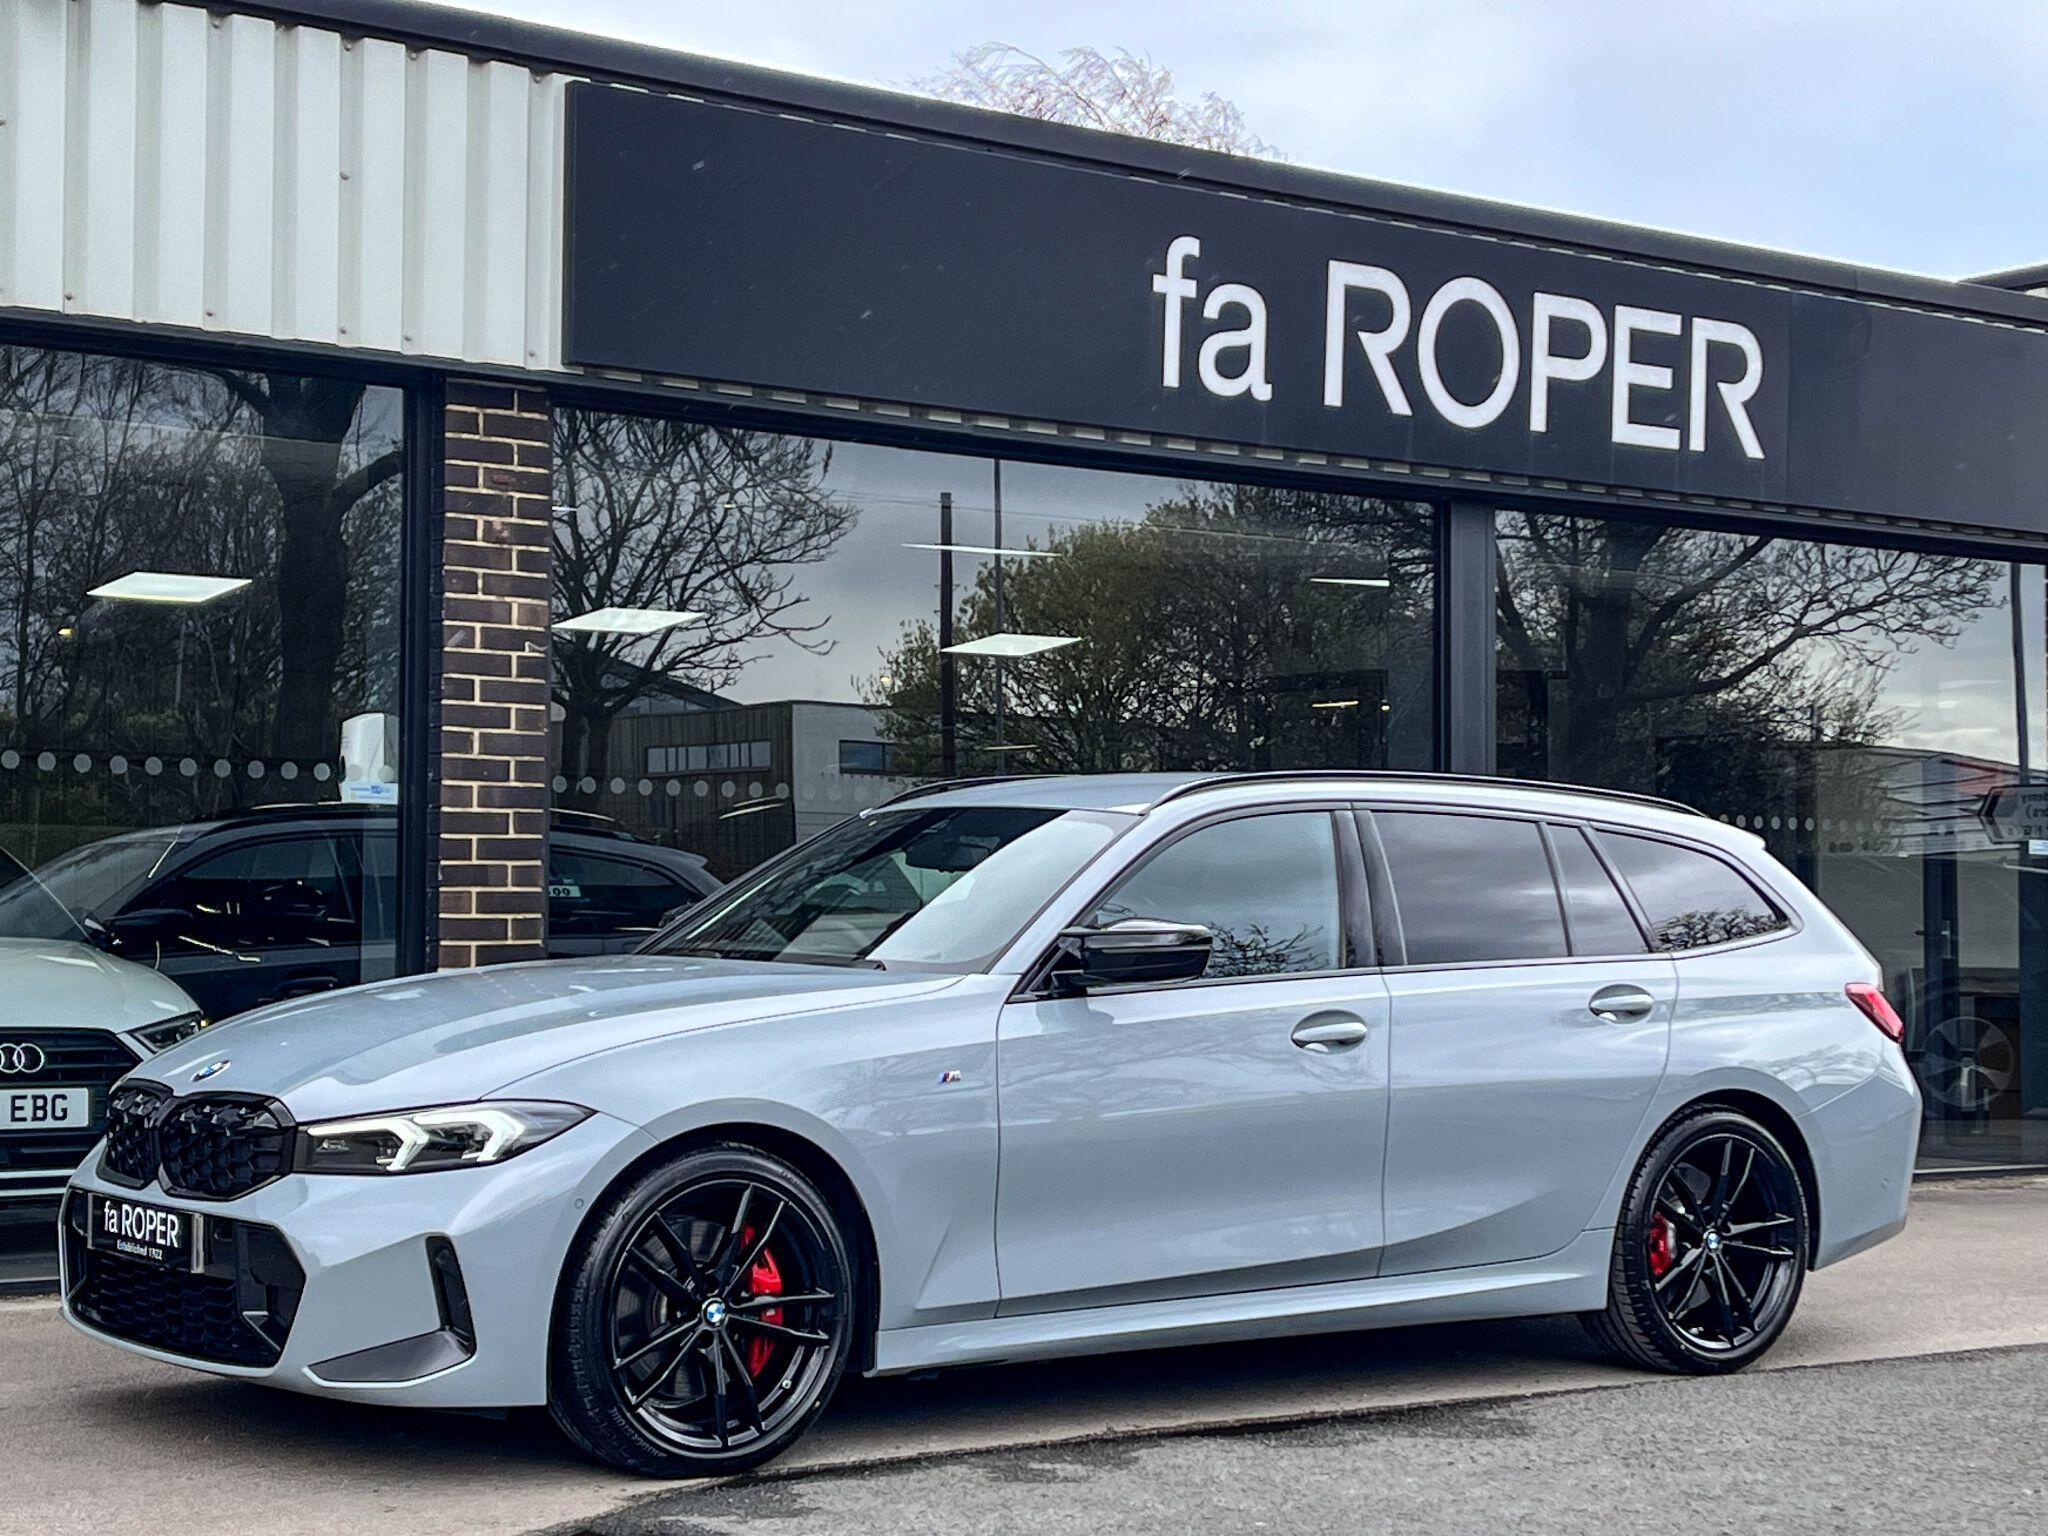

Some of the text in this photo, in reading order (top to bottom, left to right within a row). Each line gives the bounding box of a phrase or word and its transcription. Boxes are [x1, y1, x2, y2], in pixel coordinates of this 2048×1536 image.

[1152, 235, 1765, 459] fa ROPER
[10, 1094, 68, 1122] EBG
[104, 1200, 179, 1248] fa ROPER
